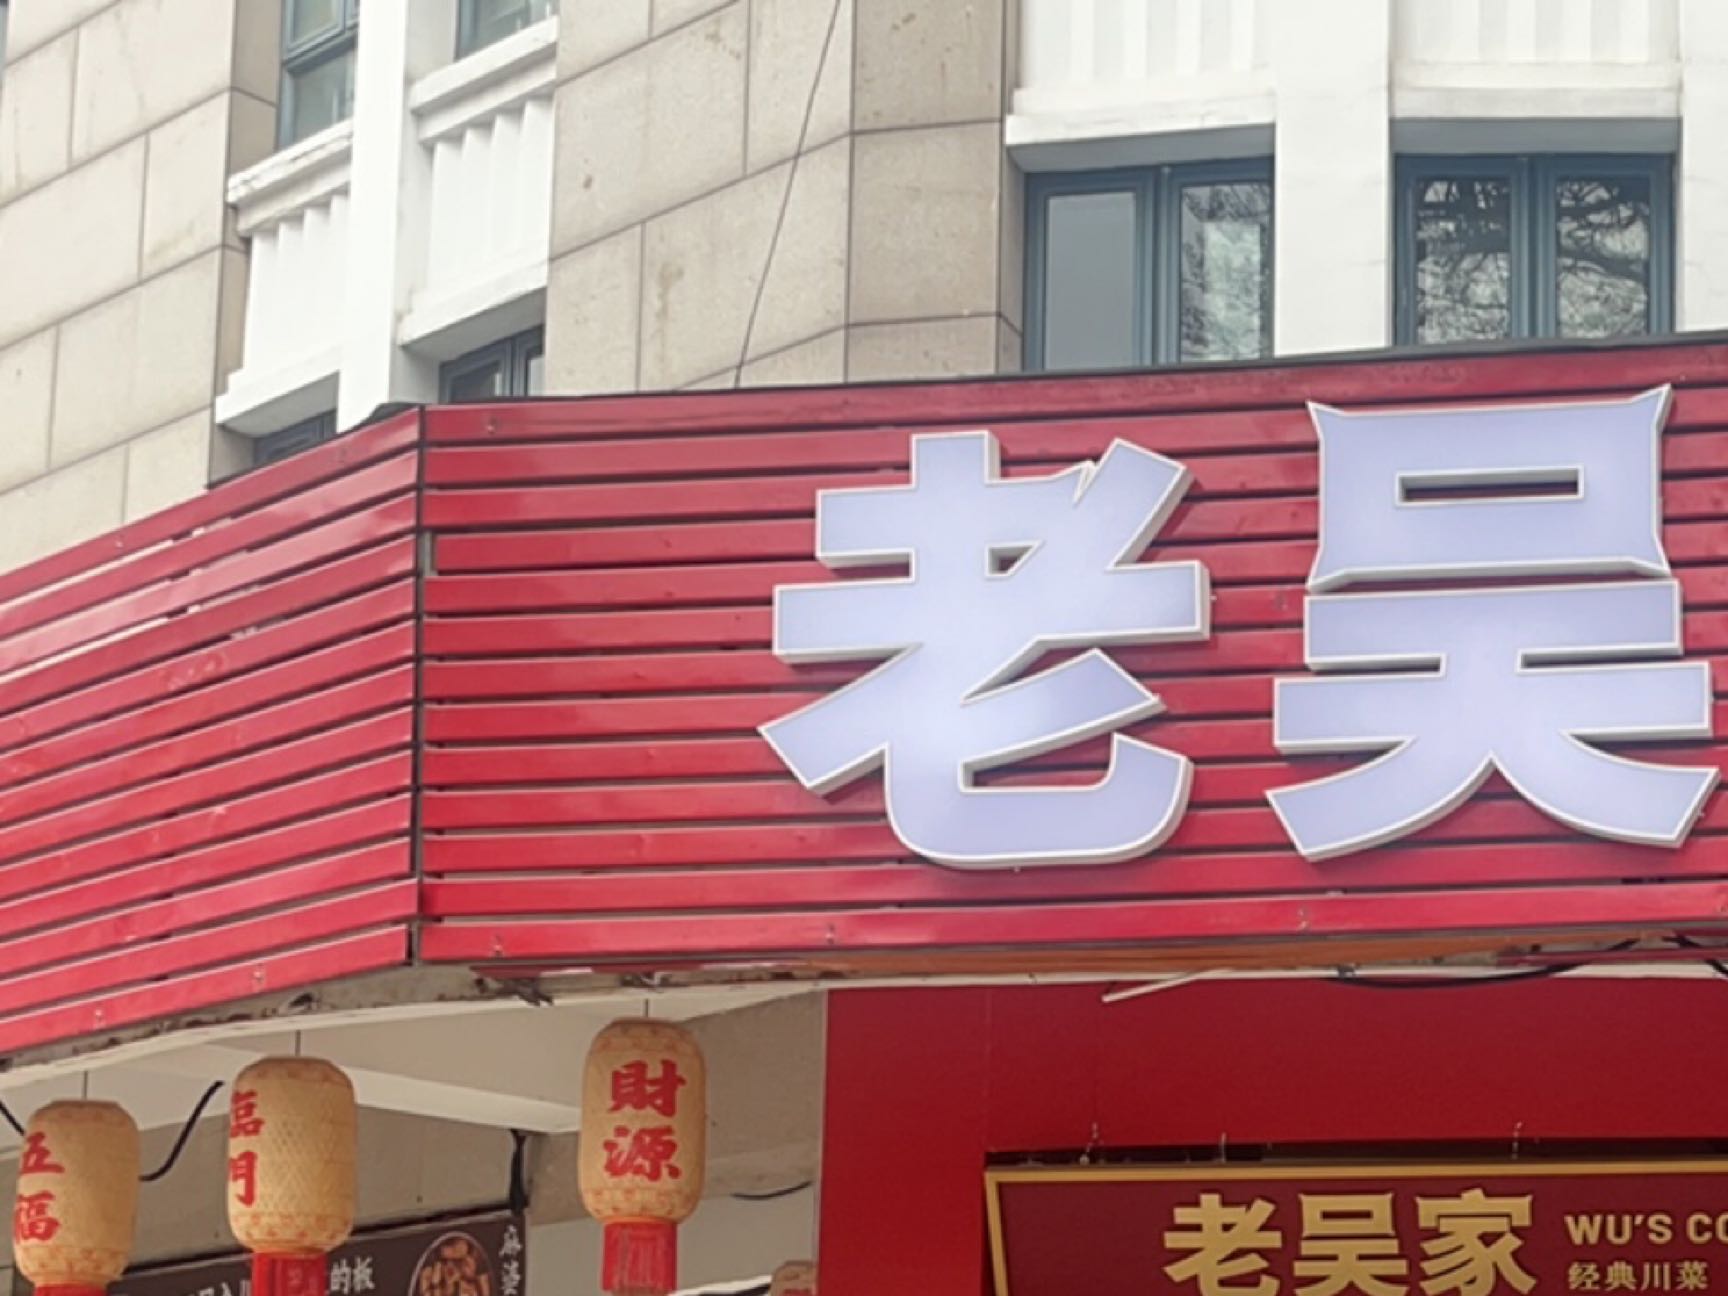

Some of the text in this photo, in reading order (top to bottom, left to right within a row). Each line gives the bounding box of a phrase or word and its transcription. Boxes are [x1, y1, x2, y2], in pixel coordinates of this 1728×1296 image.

[1563, 1213, 1674, 1246] WU'S
[1567, 1258, 1709, 1292] 经典川菜
